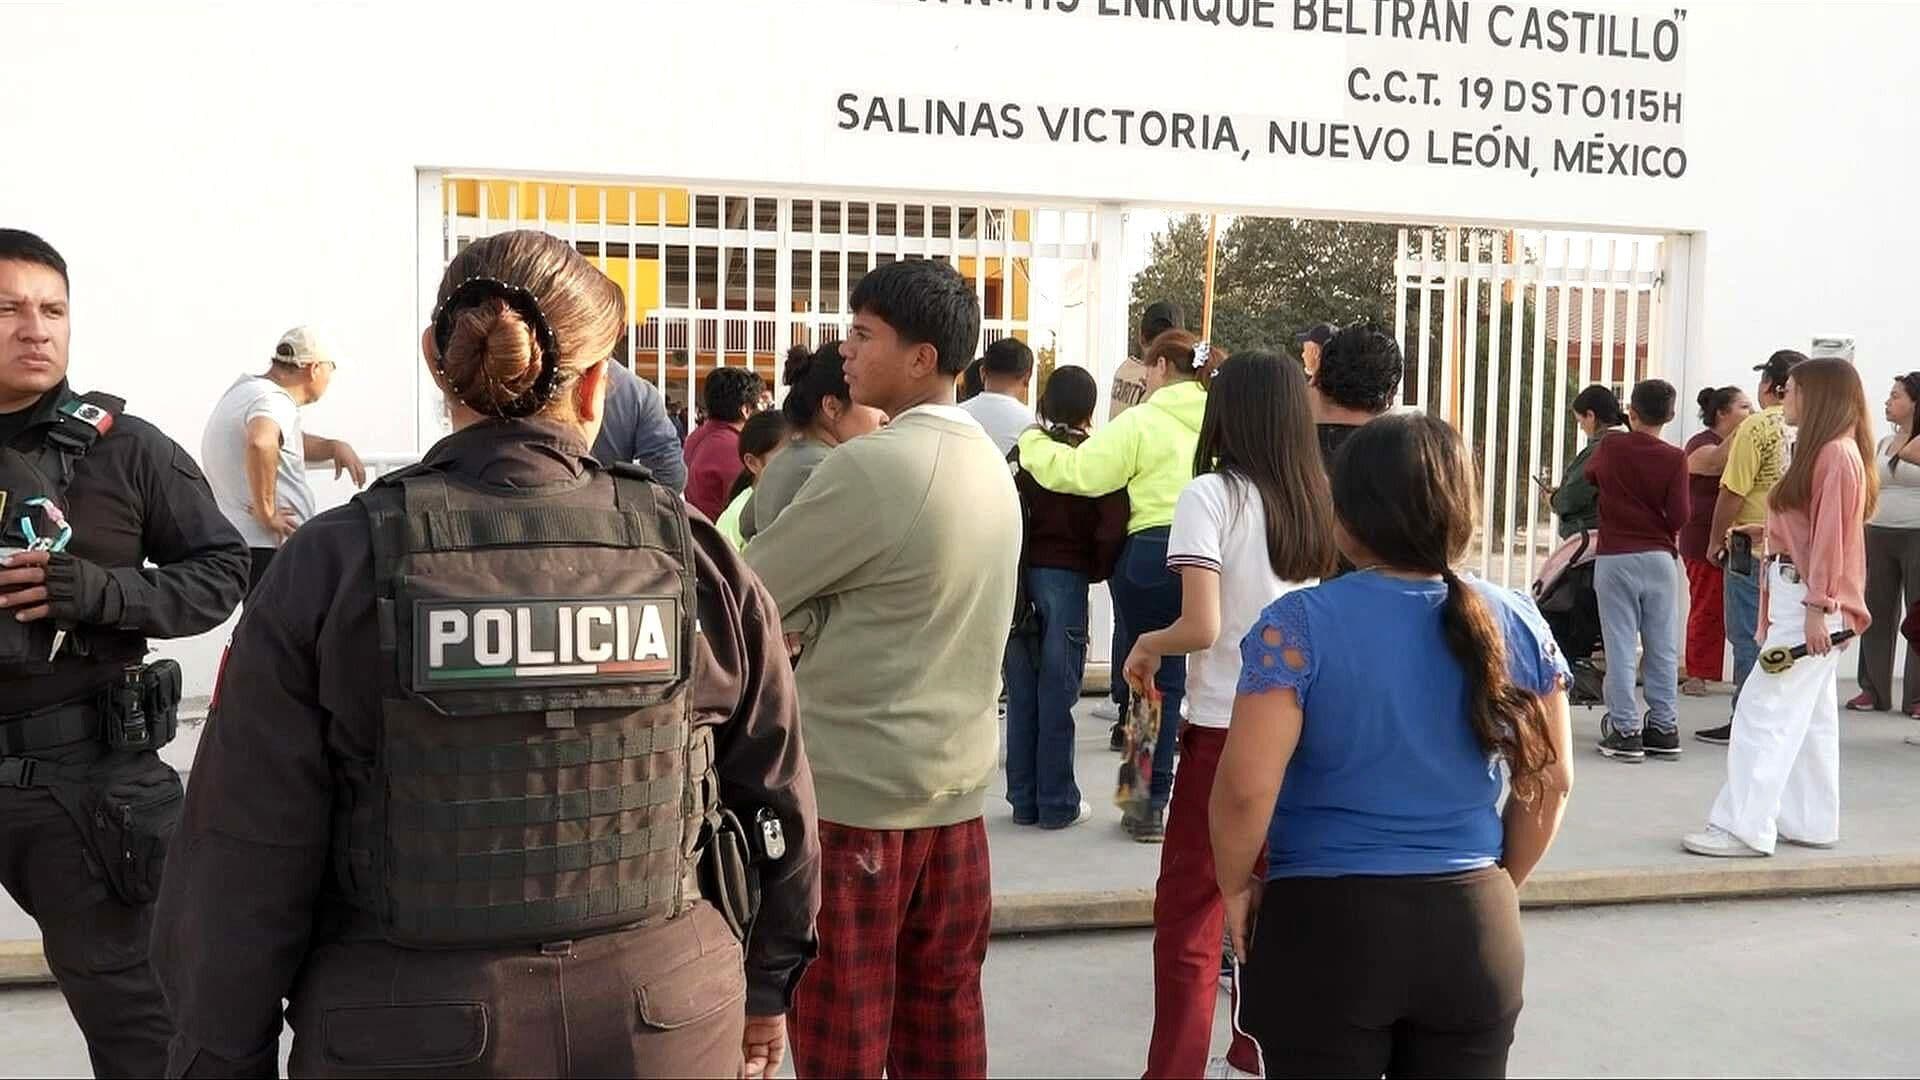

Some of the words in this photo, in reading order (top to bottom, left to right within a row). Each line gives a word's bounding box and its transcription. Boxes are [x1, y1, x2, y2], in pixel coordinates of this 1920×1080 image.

[1293, 0, 1469, 48] BELTRAN
[1347, 67, 1441, 106] C.C.T.
[837, 93, 1024, 140] SALINAS
[1037, 106, 1250, 161] VICTORIA,
[1268, 120, 1410, 162] NUEVO
[1427, 125, 1538, 178] LEÓN,
[1554, 132, 1687, 179] MÉXICO
[429, 604, 669, 668] POLICIA
